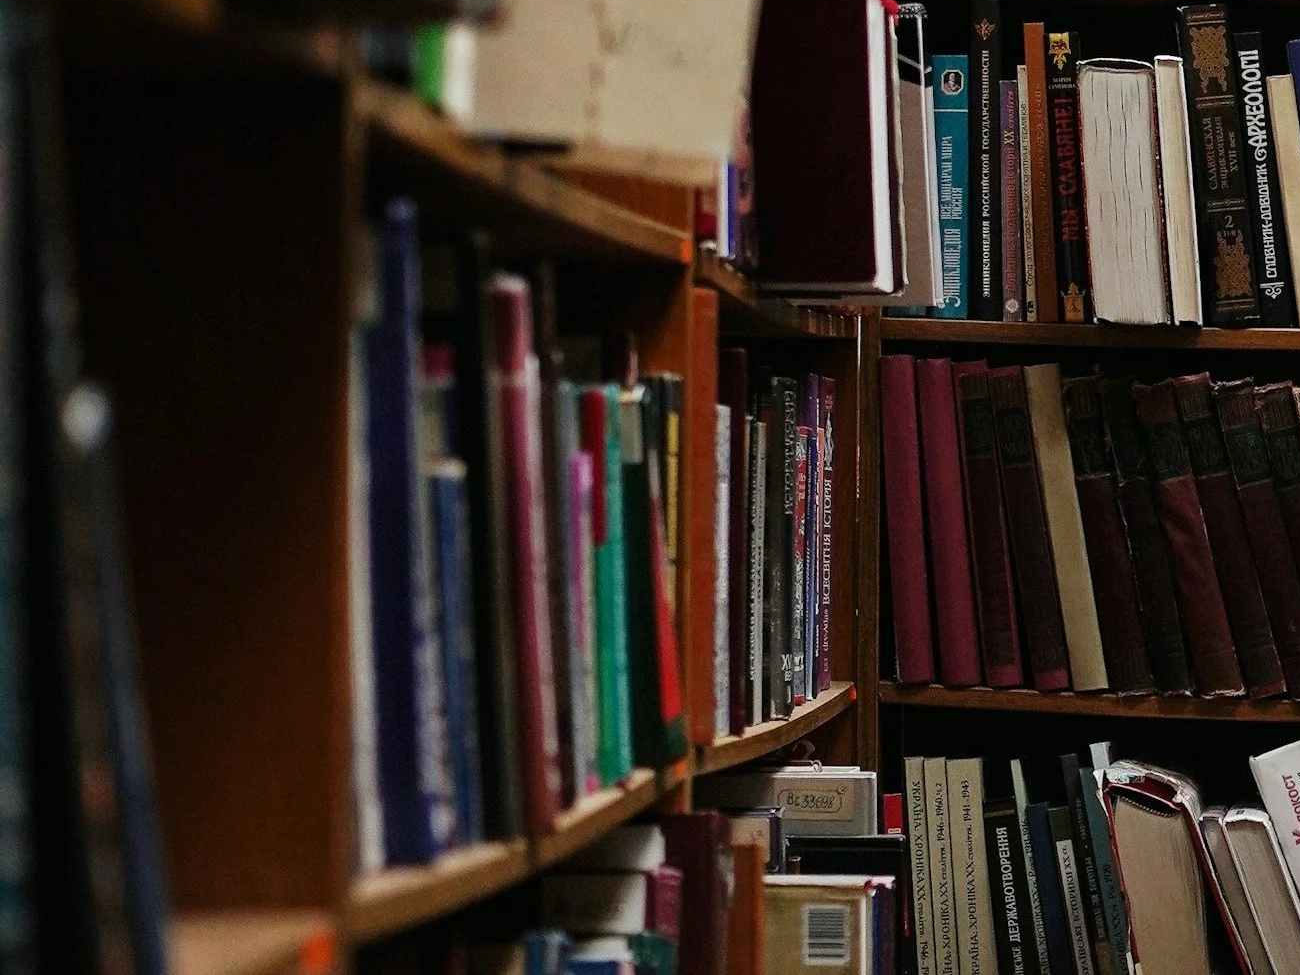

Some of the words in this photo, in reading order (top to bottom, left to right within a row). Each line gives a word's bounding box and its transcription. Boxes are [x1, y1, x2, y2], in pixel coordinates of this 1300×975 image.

[981, 50, 991, 150] ГОСУДАРСТВЕННОСТИ
[980, 153, 990, 218] РОССИЙСКОЙ
[1203, 117, 1218, 190] СЛАВЯНСКАЯ
[1214, 116, 1229, 189] ЭНЦИКЛОПЕДИЯ
[951, 187, 963, 220] РОССИЯ
[1224, 214, 1235, 229] 2
[982, 220, 991, 298] ЭНЦИКЛОПЕДИЯ
[823, 478, 832, 528] ІСТОРІЯ
[822, 534, 831, 606] ВСЕСВІТНЯ
